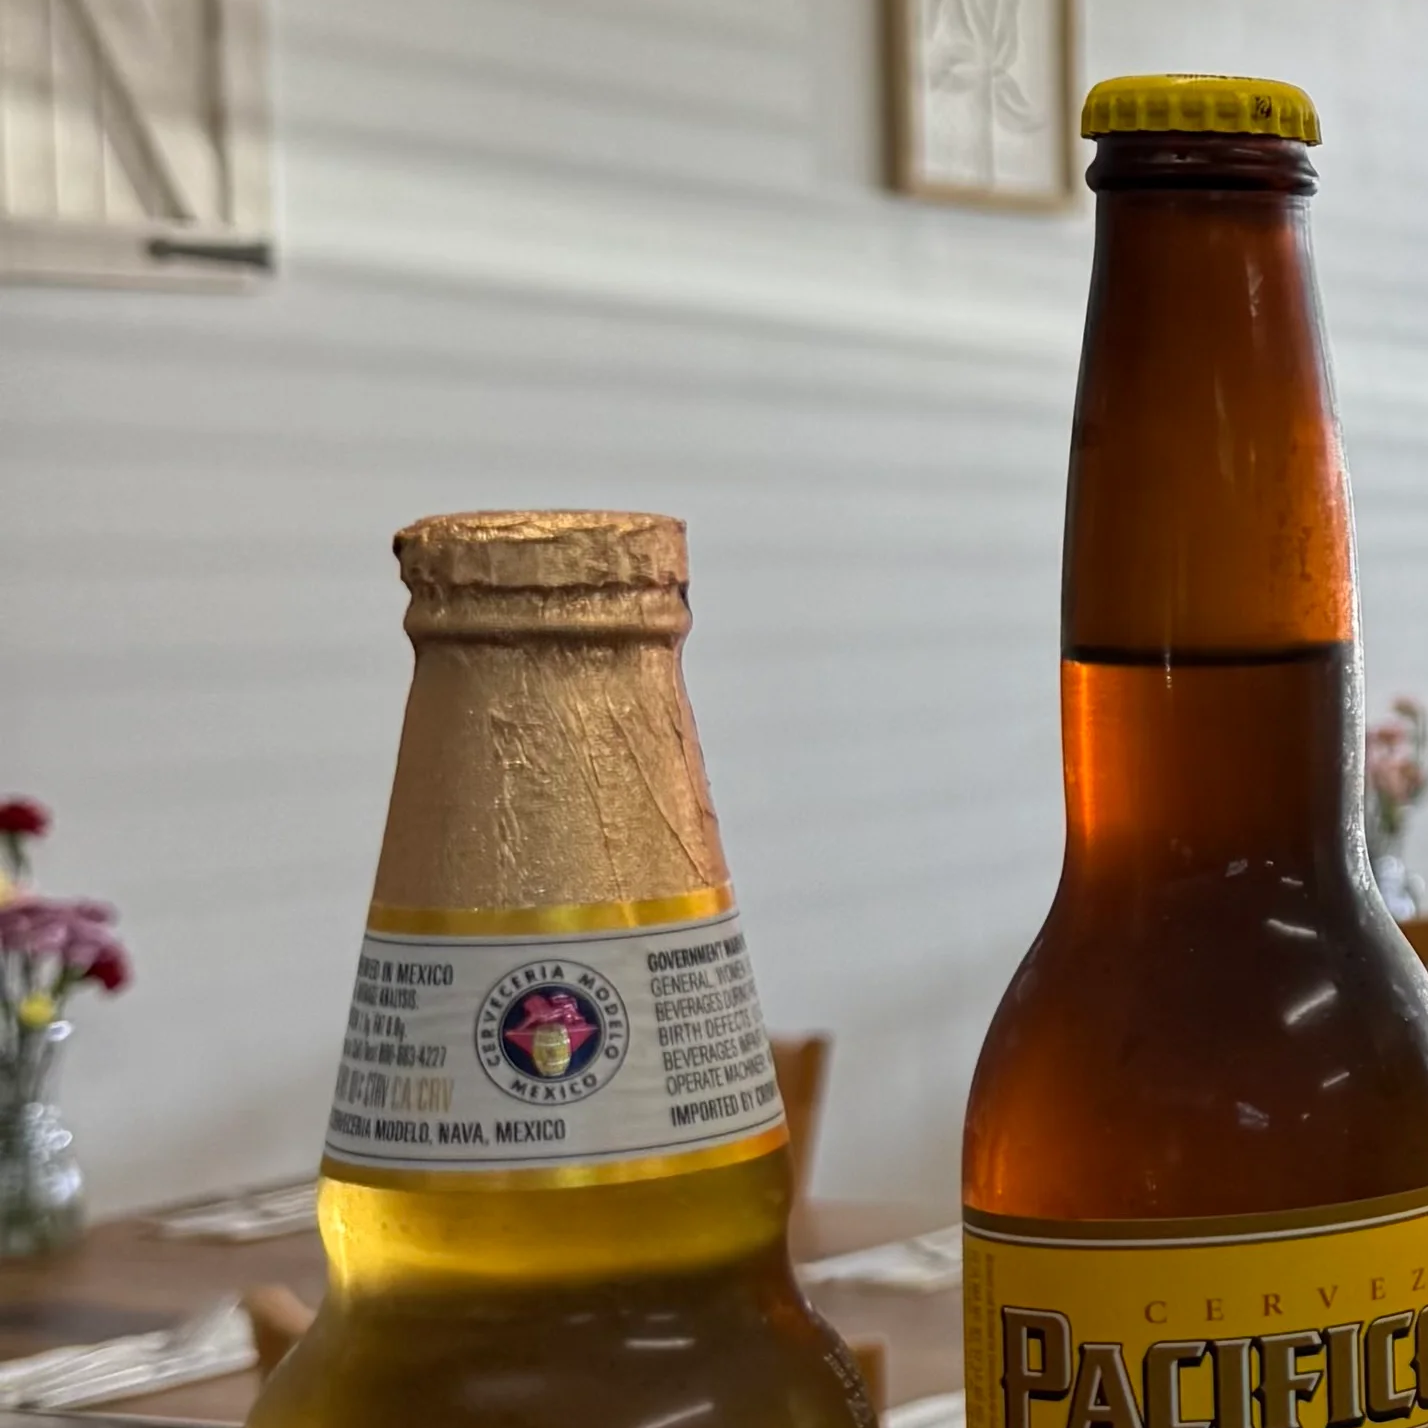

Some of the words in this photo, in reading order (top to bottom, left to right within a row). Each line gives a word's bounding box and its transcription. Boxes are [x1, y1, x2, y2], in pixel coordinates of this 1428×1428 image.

[647, 940, 724, 973] GOVERNMENT
[396, 963, 454, 986] MEXICO
[650, 971, 714, 997] GENERAL
[481, 964, 565, 1067] CERVECERIA
[578, 973, 624, 1060] MODELO
[655, 988, 724, 1022] BEVERAGES
[658, 1022, 702, 1047] BIRTH
[662, 1039, 739, 1072] BEVERAGES
[511, 1074, 598, 1100] MEXICO
[666, 1066, 724, 1097] OPERATE
[670, 1095, 739, 1128] IMPORTED
[739, 1091, 755, 1112] BY
[374, 1120, 433, 1146] MODELO,
[438, 1122, 490, 1147] NAVA,
[496, 1119, 567, 1143] MEXICO
